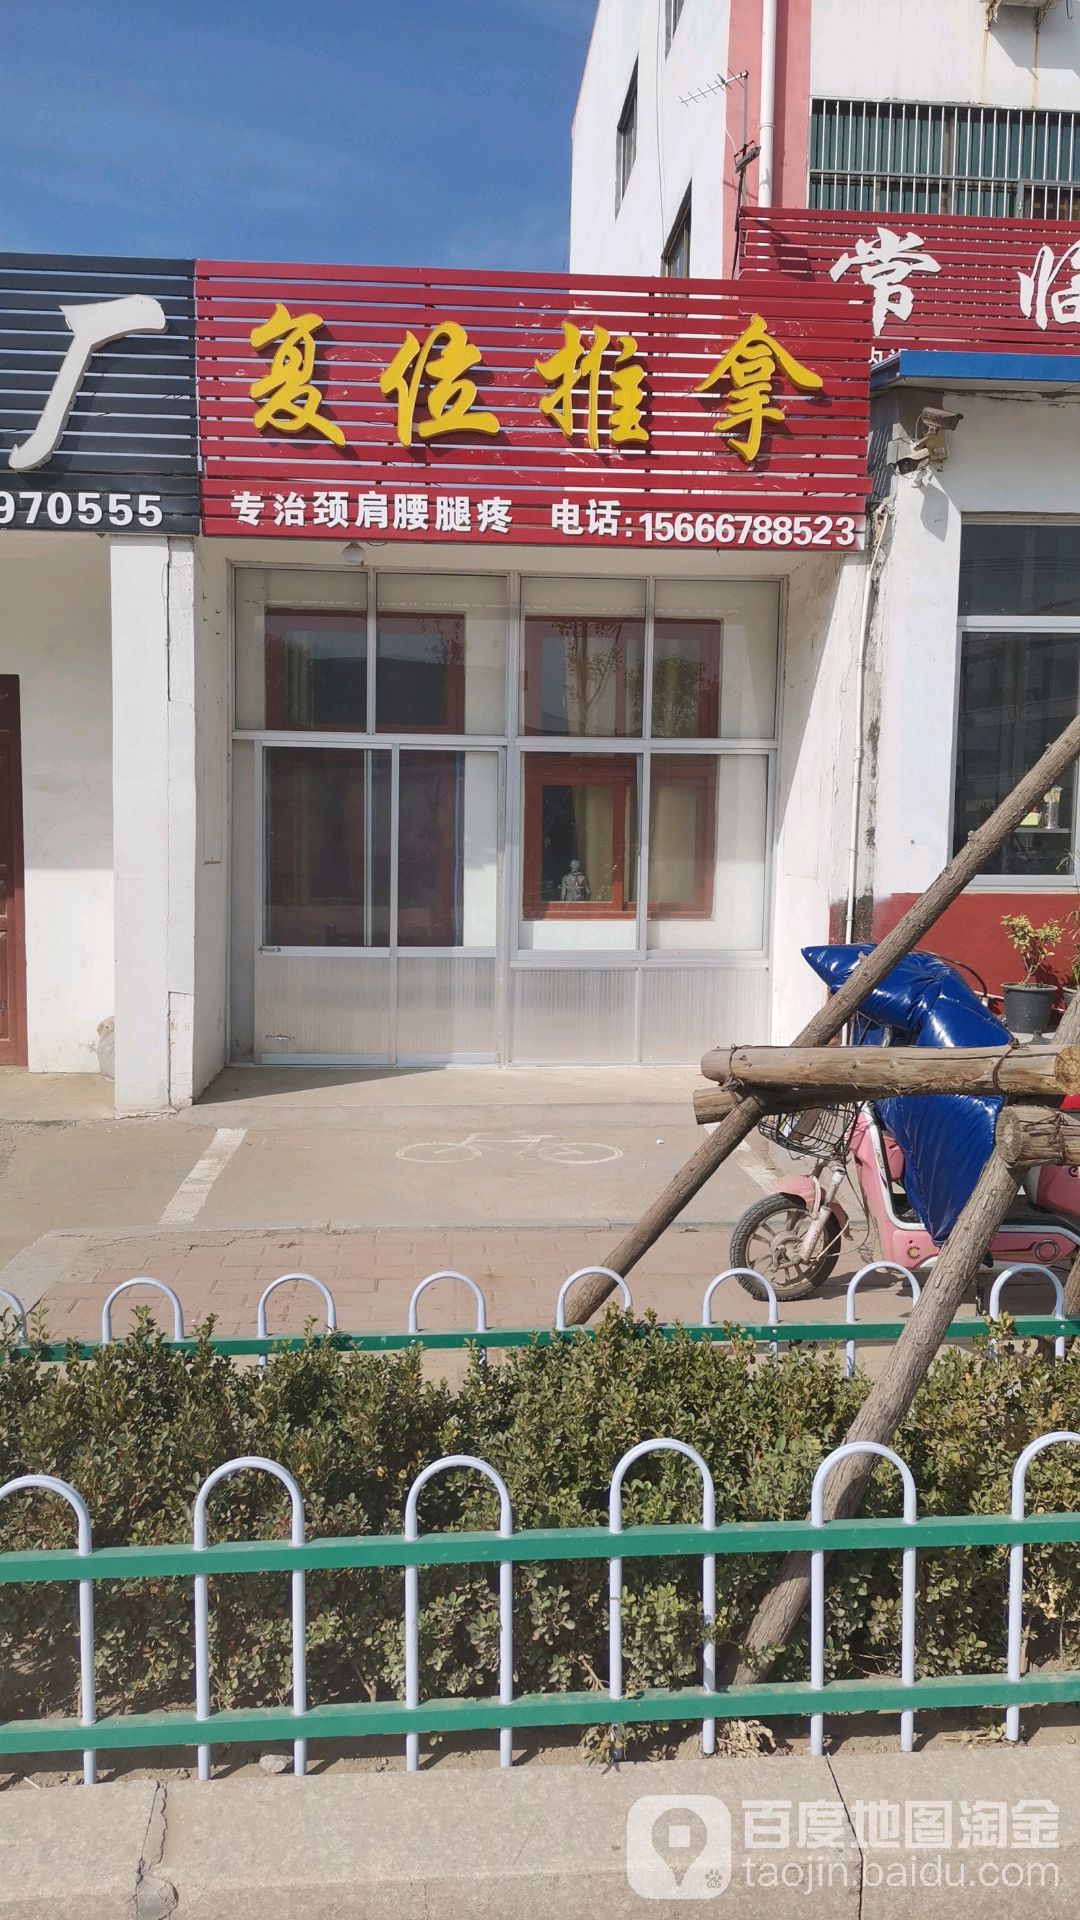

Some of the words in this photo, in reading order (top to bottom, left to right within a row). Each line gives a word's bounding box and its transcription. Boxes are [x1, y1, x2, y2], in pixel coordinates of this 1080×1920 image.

[8, 293, 168, 472] 厂
[250, 302, 824, 464] 复位推拿
[0, 491, 163, 527] 970555
[230, 490, 513, 534] 专治颈肩腰腿疼
